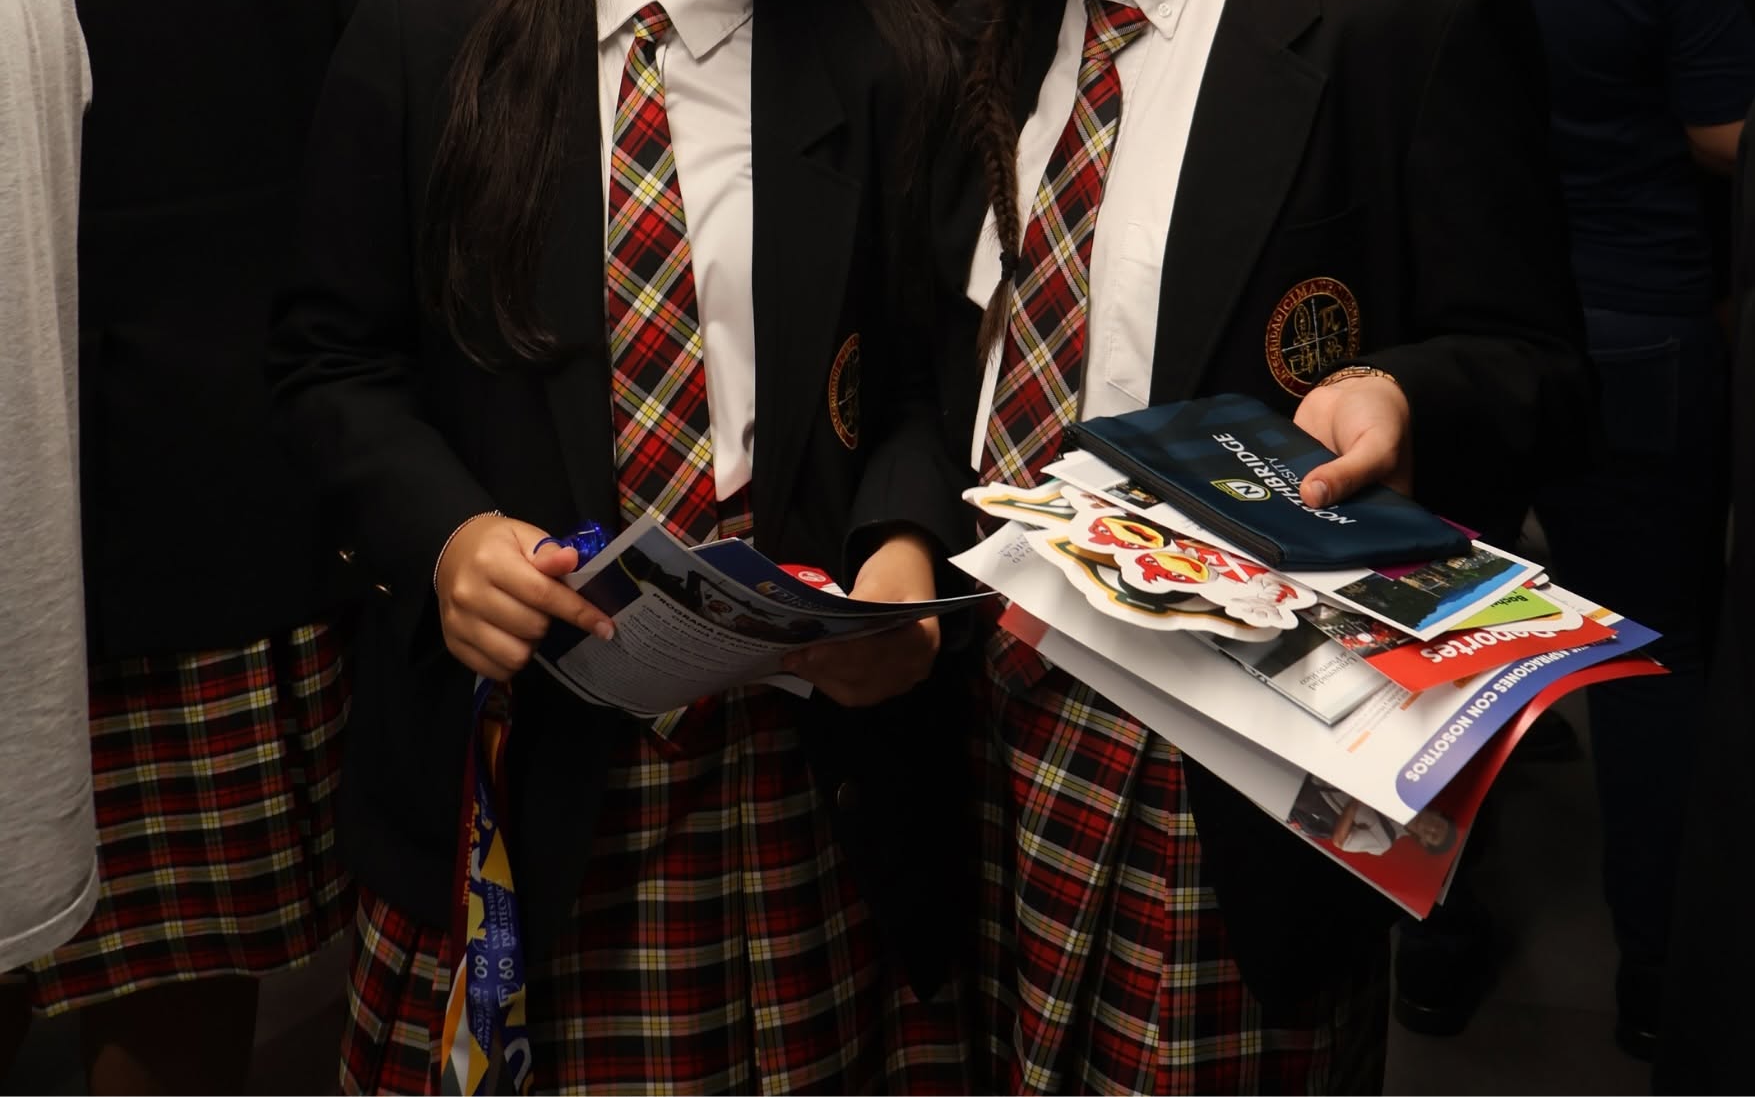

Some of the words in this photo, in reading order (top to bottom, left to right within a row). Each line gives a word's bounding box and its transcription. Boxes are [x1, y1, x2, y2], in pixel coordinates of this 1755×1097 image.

[652, 592, 714, 633] PROGRAMA
[1493, 647, 1570, 693] ASPIRACIONES
[1466, 692, 1498, 718] CON
[1405, 718, 1474, 782] NOSOTROS
[474, 954, 489, 978] 60
[498, 957, 515, 980] 60
